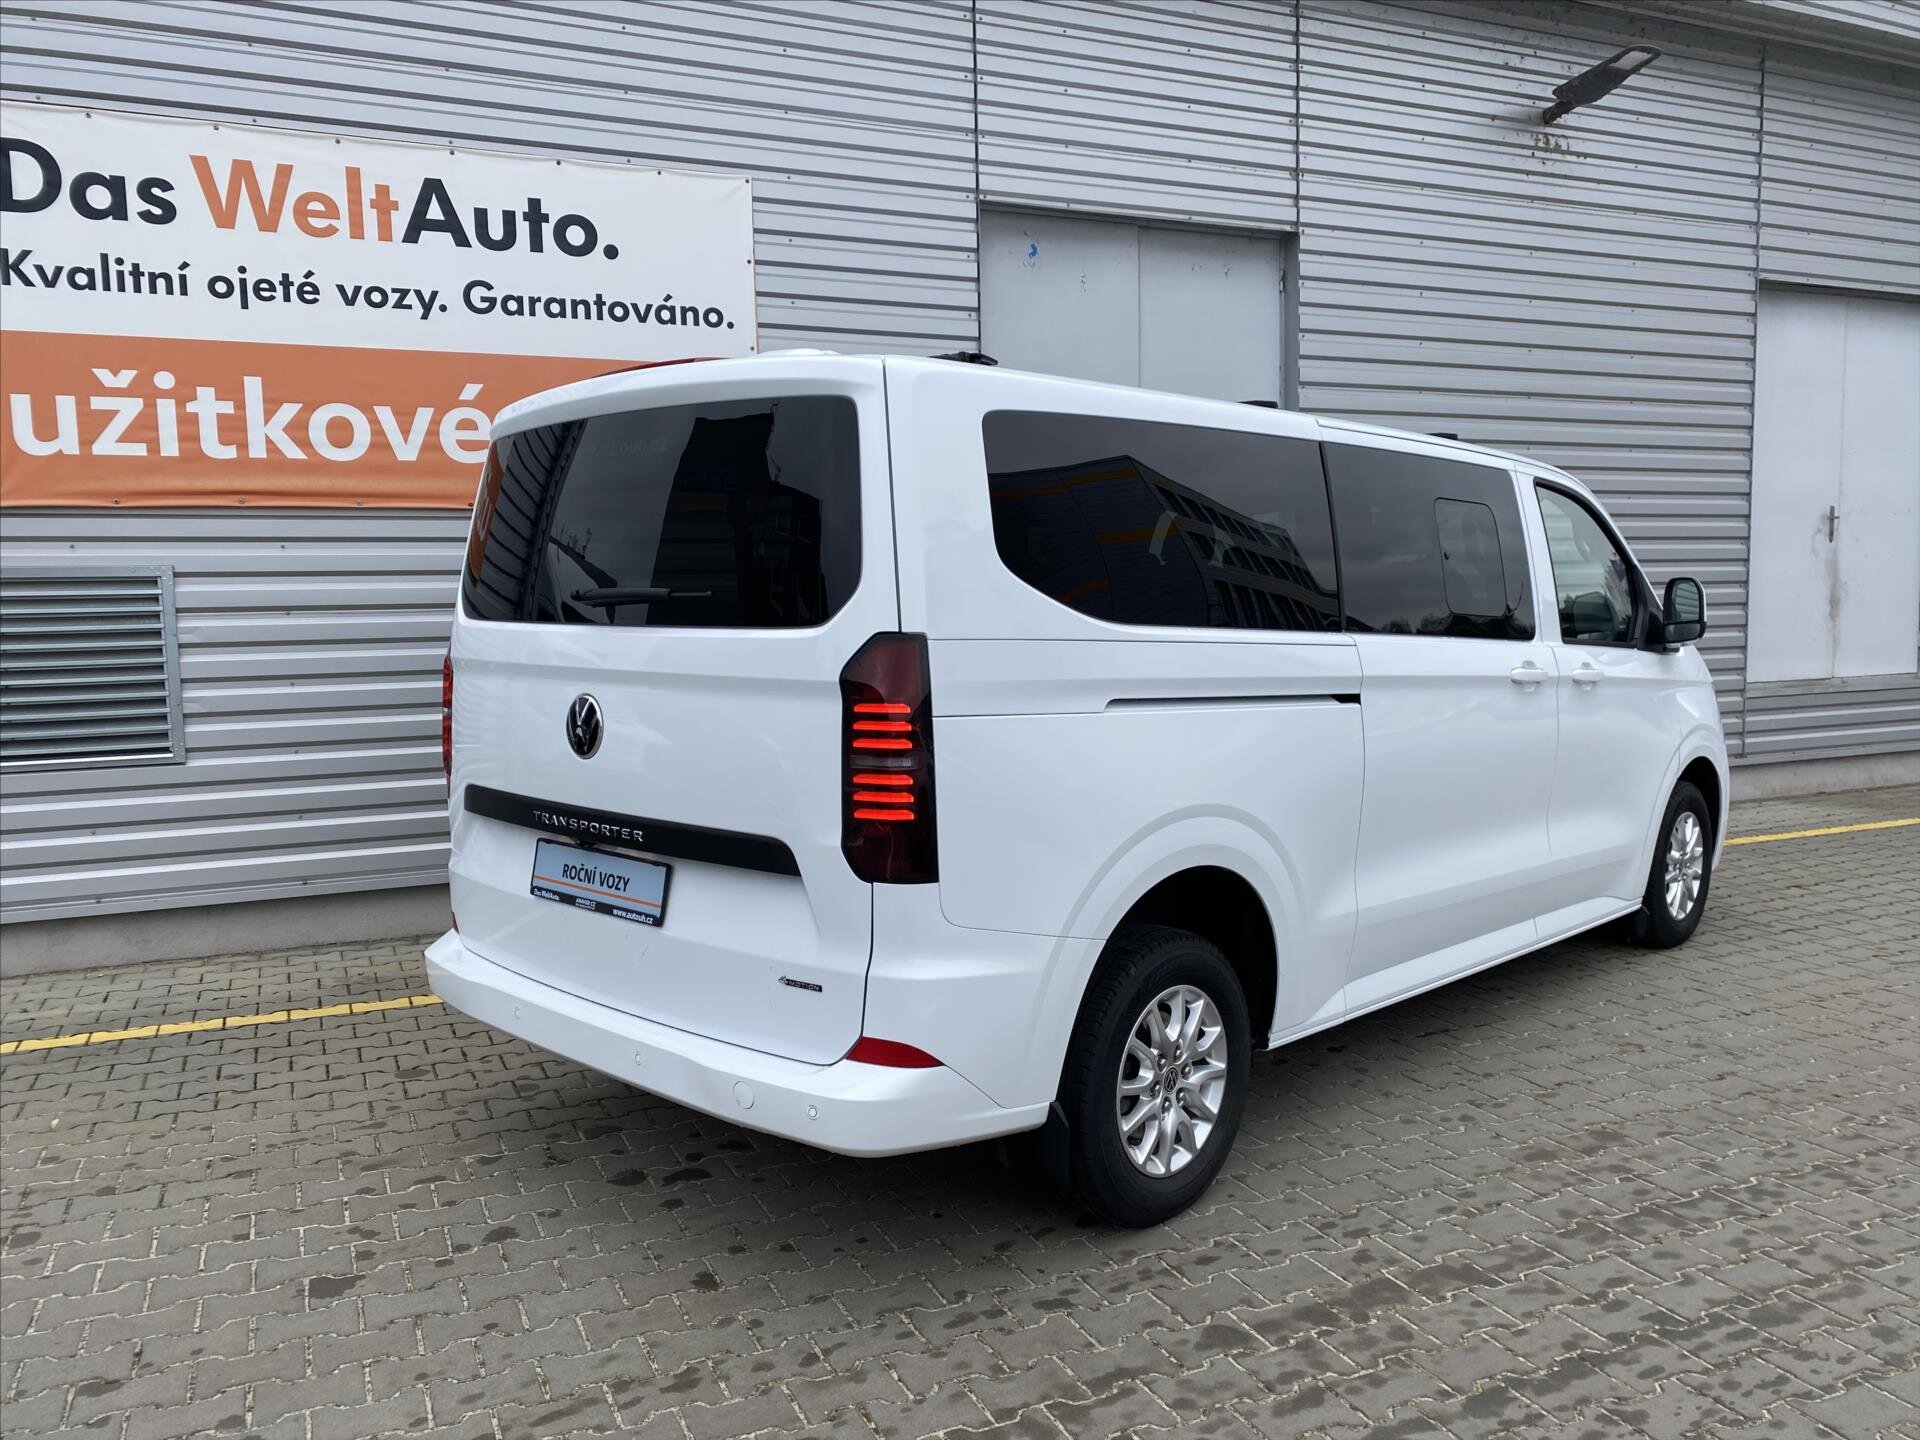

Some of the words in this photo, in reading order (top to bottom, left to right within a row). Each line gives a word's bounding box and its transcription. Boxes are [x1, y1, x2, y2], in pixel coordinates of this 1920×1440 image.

[0, 136, 178, 225] Das
[189, 154, 620, 260] WeltAuto.
[0, 247, 191, 296] Kvalitní
[206, 265, 321, 310] ojeté
[335, 283, 448, 320] vozy.
[462, 279, 735, 330] Garantováno.
[9, 367, 493, 464] užitkové
[532, 810, 643, 842] TRANSPORTER
[562, 863, 597, 885] ROČNÍ
[599, 871, 630, 892] VOZY
